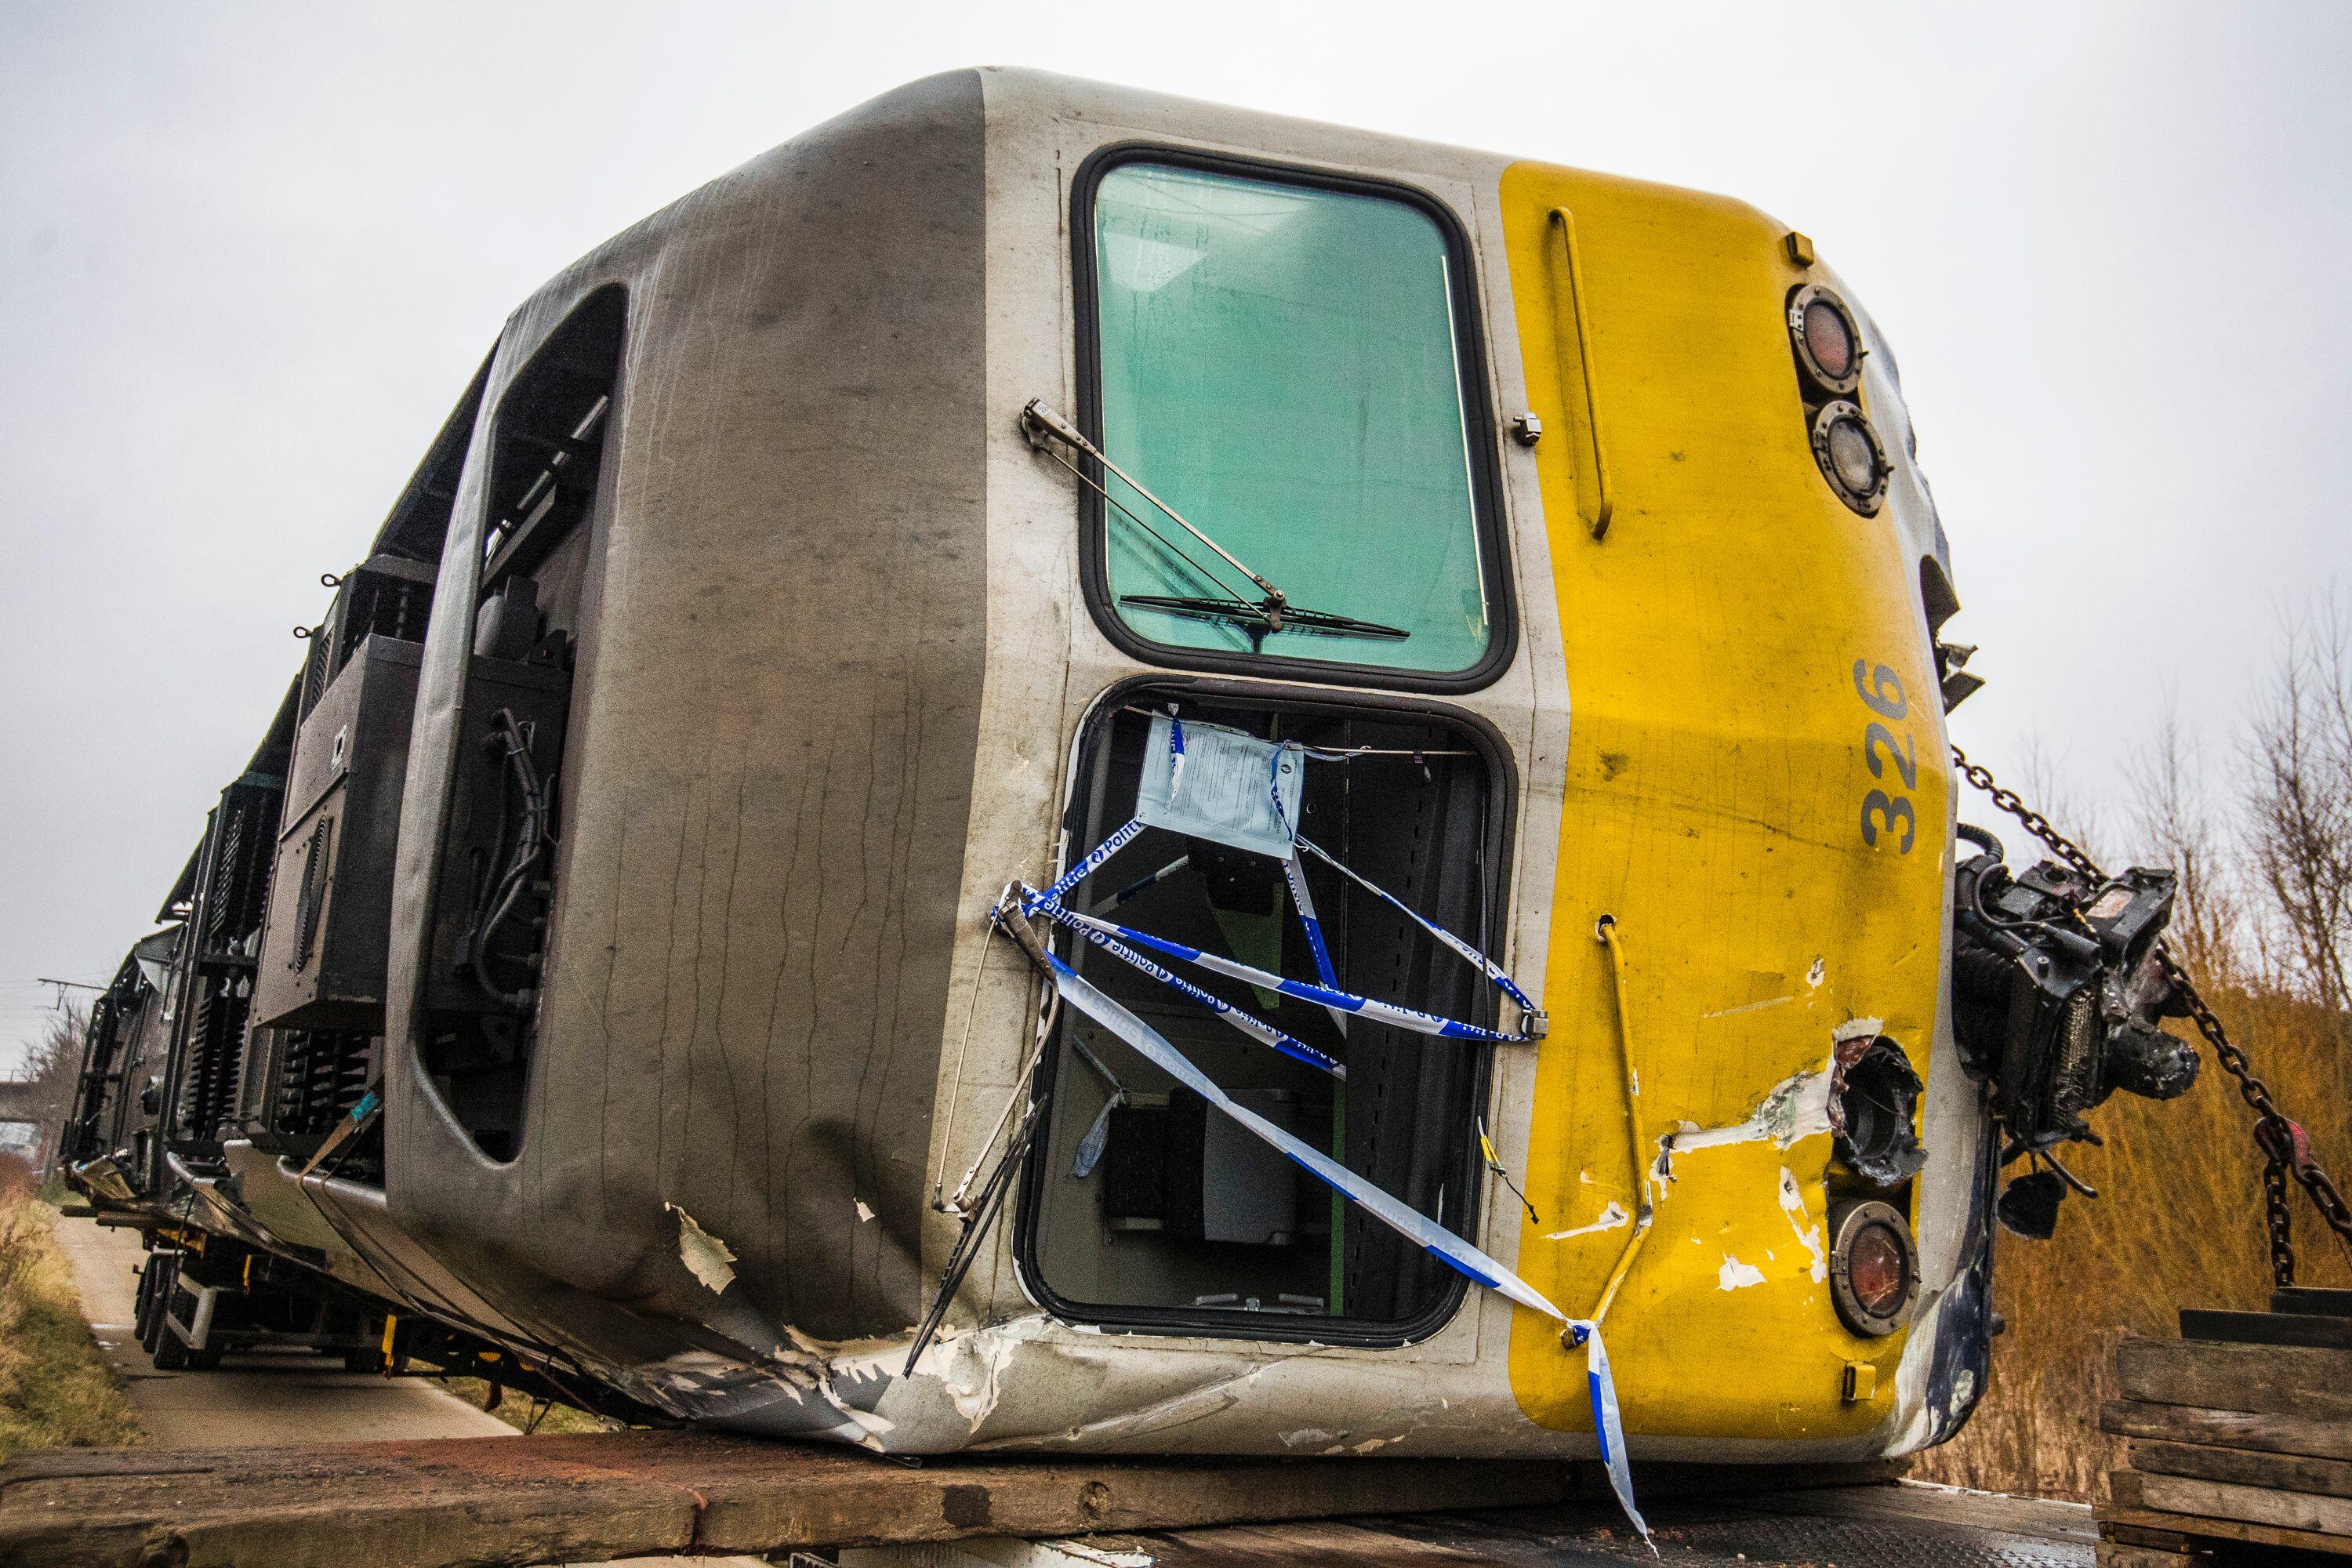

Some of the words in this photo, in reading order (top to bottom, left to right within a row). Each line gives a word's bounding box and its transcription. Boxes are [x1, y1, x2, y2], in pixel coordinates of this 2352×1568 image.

[1853, 659, 1917, 855] 326
[1052, 867, 1087, 901] litie
[1104, 820, 1142, 855] Politi
[1044, 901, 1091, 936] Politie
[1112, 942, 1154, 972] Politie
